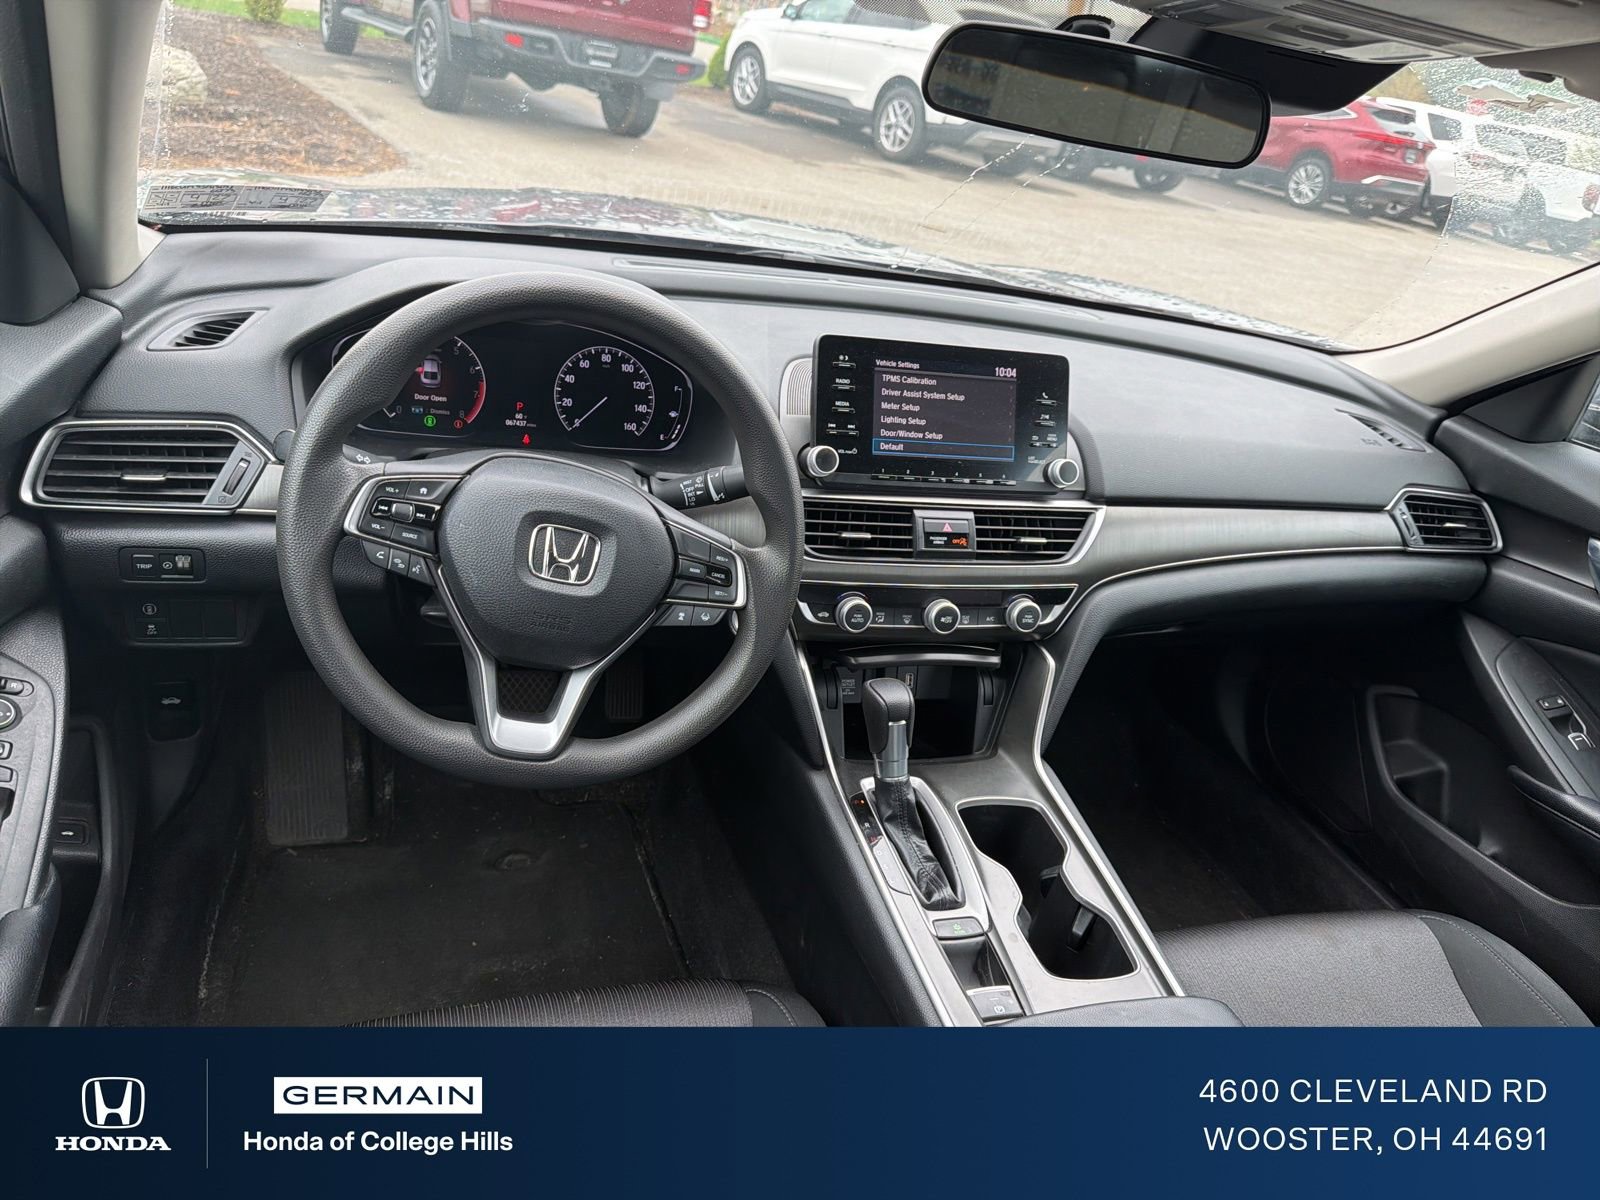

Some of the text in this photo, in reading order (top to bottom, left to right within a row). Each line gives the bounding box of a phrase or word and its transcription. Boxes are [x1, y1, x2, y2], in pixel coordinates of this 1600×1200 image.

[454, 347, 459, 355] 5
[601, 354, 611, 363] 80
[579, 360, 590, 368] 60
[621, 363, 634, 373] 100
[876, 359, 920, 369] Vehicle Settings
[995, 367, 1016, 377] 10:04
[564, 375, 575, 383] 40
[882, 374, 937, 385] TPMS Calibration
[633, 381, 646, 390] 120
[881, 388, 965, 402] Driver Assist System Setup
[517, 401, 524, 411] P
[562, 398, 573, 407] 20
[881, 401, 920, 412] Meter Setup
[634, 404, 648, 413] 140
[505, 419, 527, 427] 067437
[881, 415, 926, 426] Lighting Setup
[624, 422, 637, 431] 160
[880, 429, 943, 440] Door/Window Setup
[880, 442, 904, 451] Default
[402, 532, 418, 540] SOURCE
